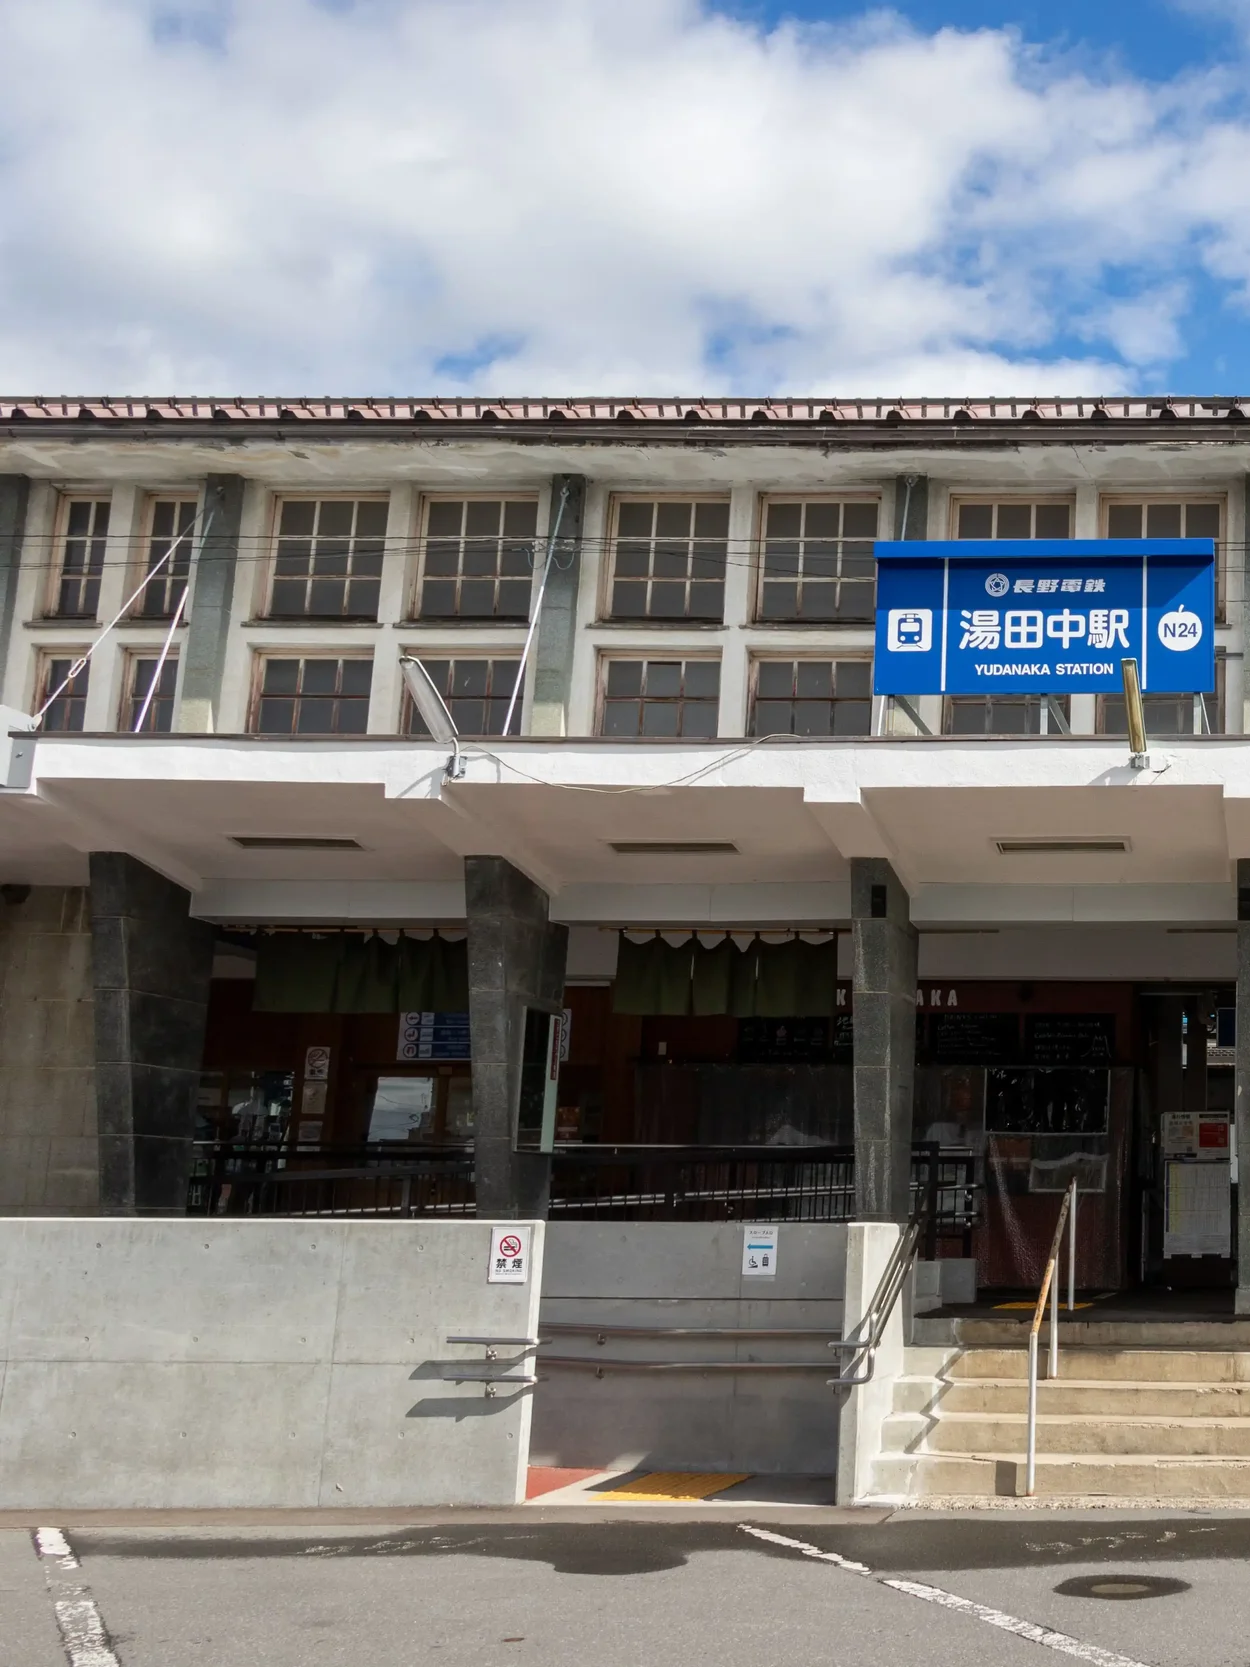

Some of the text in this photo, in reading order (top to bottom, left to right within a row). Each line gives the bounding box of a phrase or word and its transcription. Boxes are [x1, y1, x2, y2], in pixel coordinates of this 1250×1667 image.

[1012, 578, 1106, 593] 長野電鉄
[958, 608, 1130, 650] 湯田中駅
[1163, 622, 1198, 638] N24
[974, 662, 1114, 676] YUDANAKA STATION
[496, 1258, 523, 1269] 禁煙
